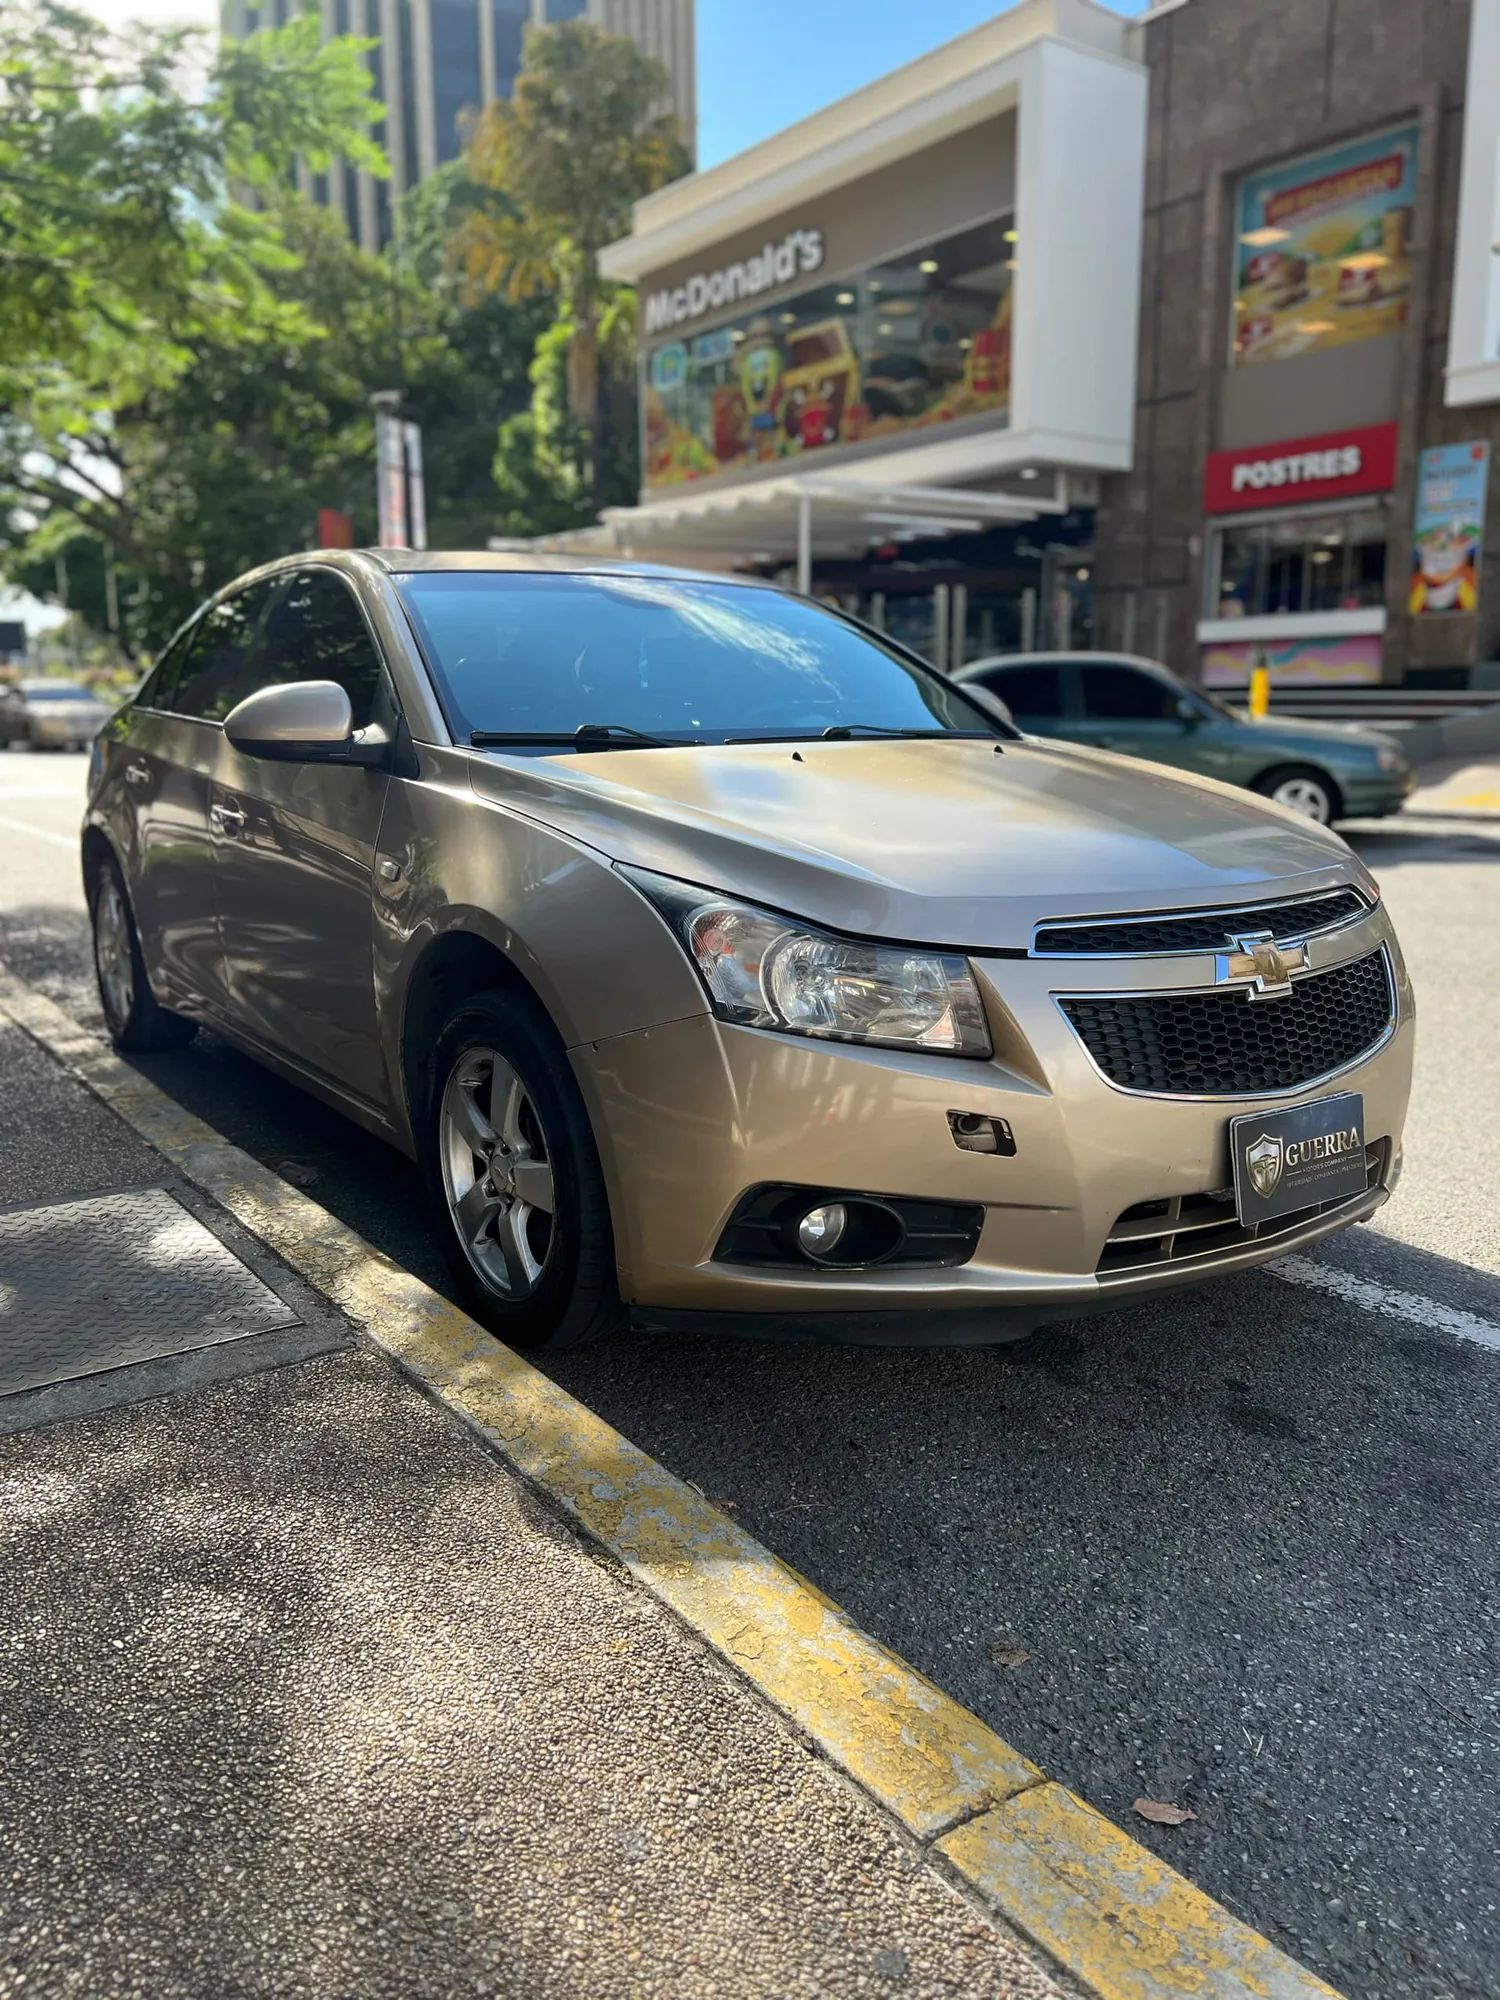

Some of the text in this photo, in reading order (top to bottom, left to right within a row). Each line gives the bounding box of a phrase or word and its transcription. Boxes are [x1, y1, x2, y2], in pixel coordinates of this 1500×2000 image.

[645, 229, 823, 332] McDonald's
[1232, 445, 1361, 492] POSTRES
[1285, 1126, 1361, 1167] GUERRA
